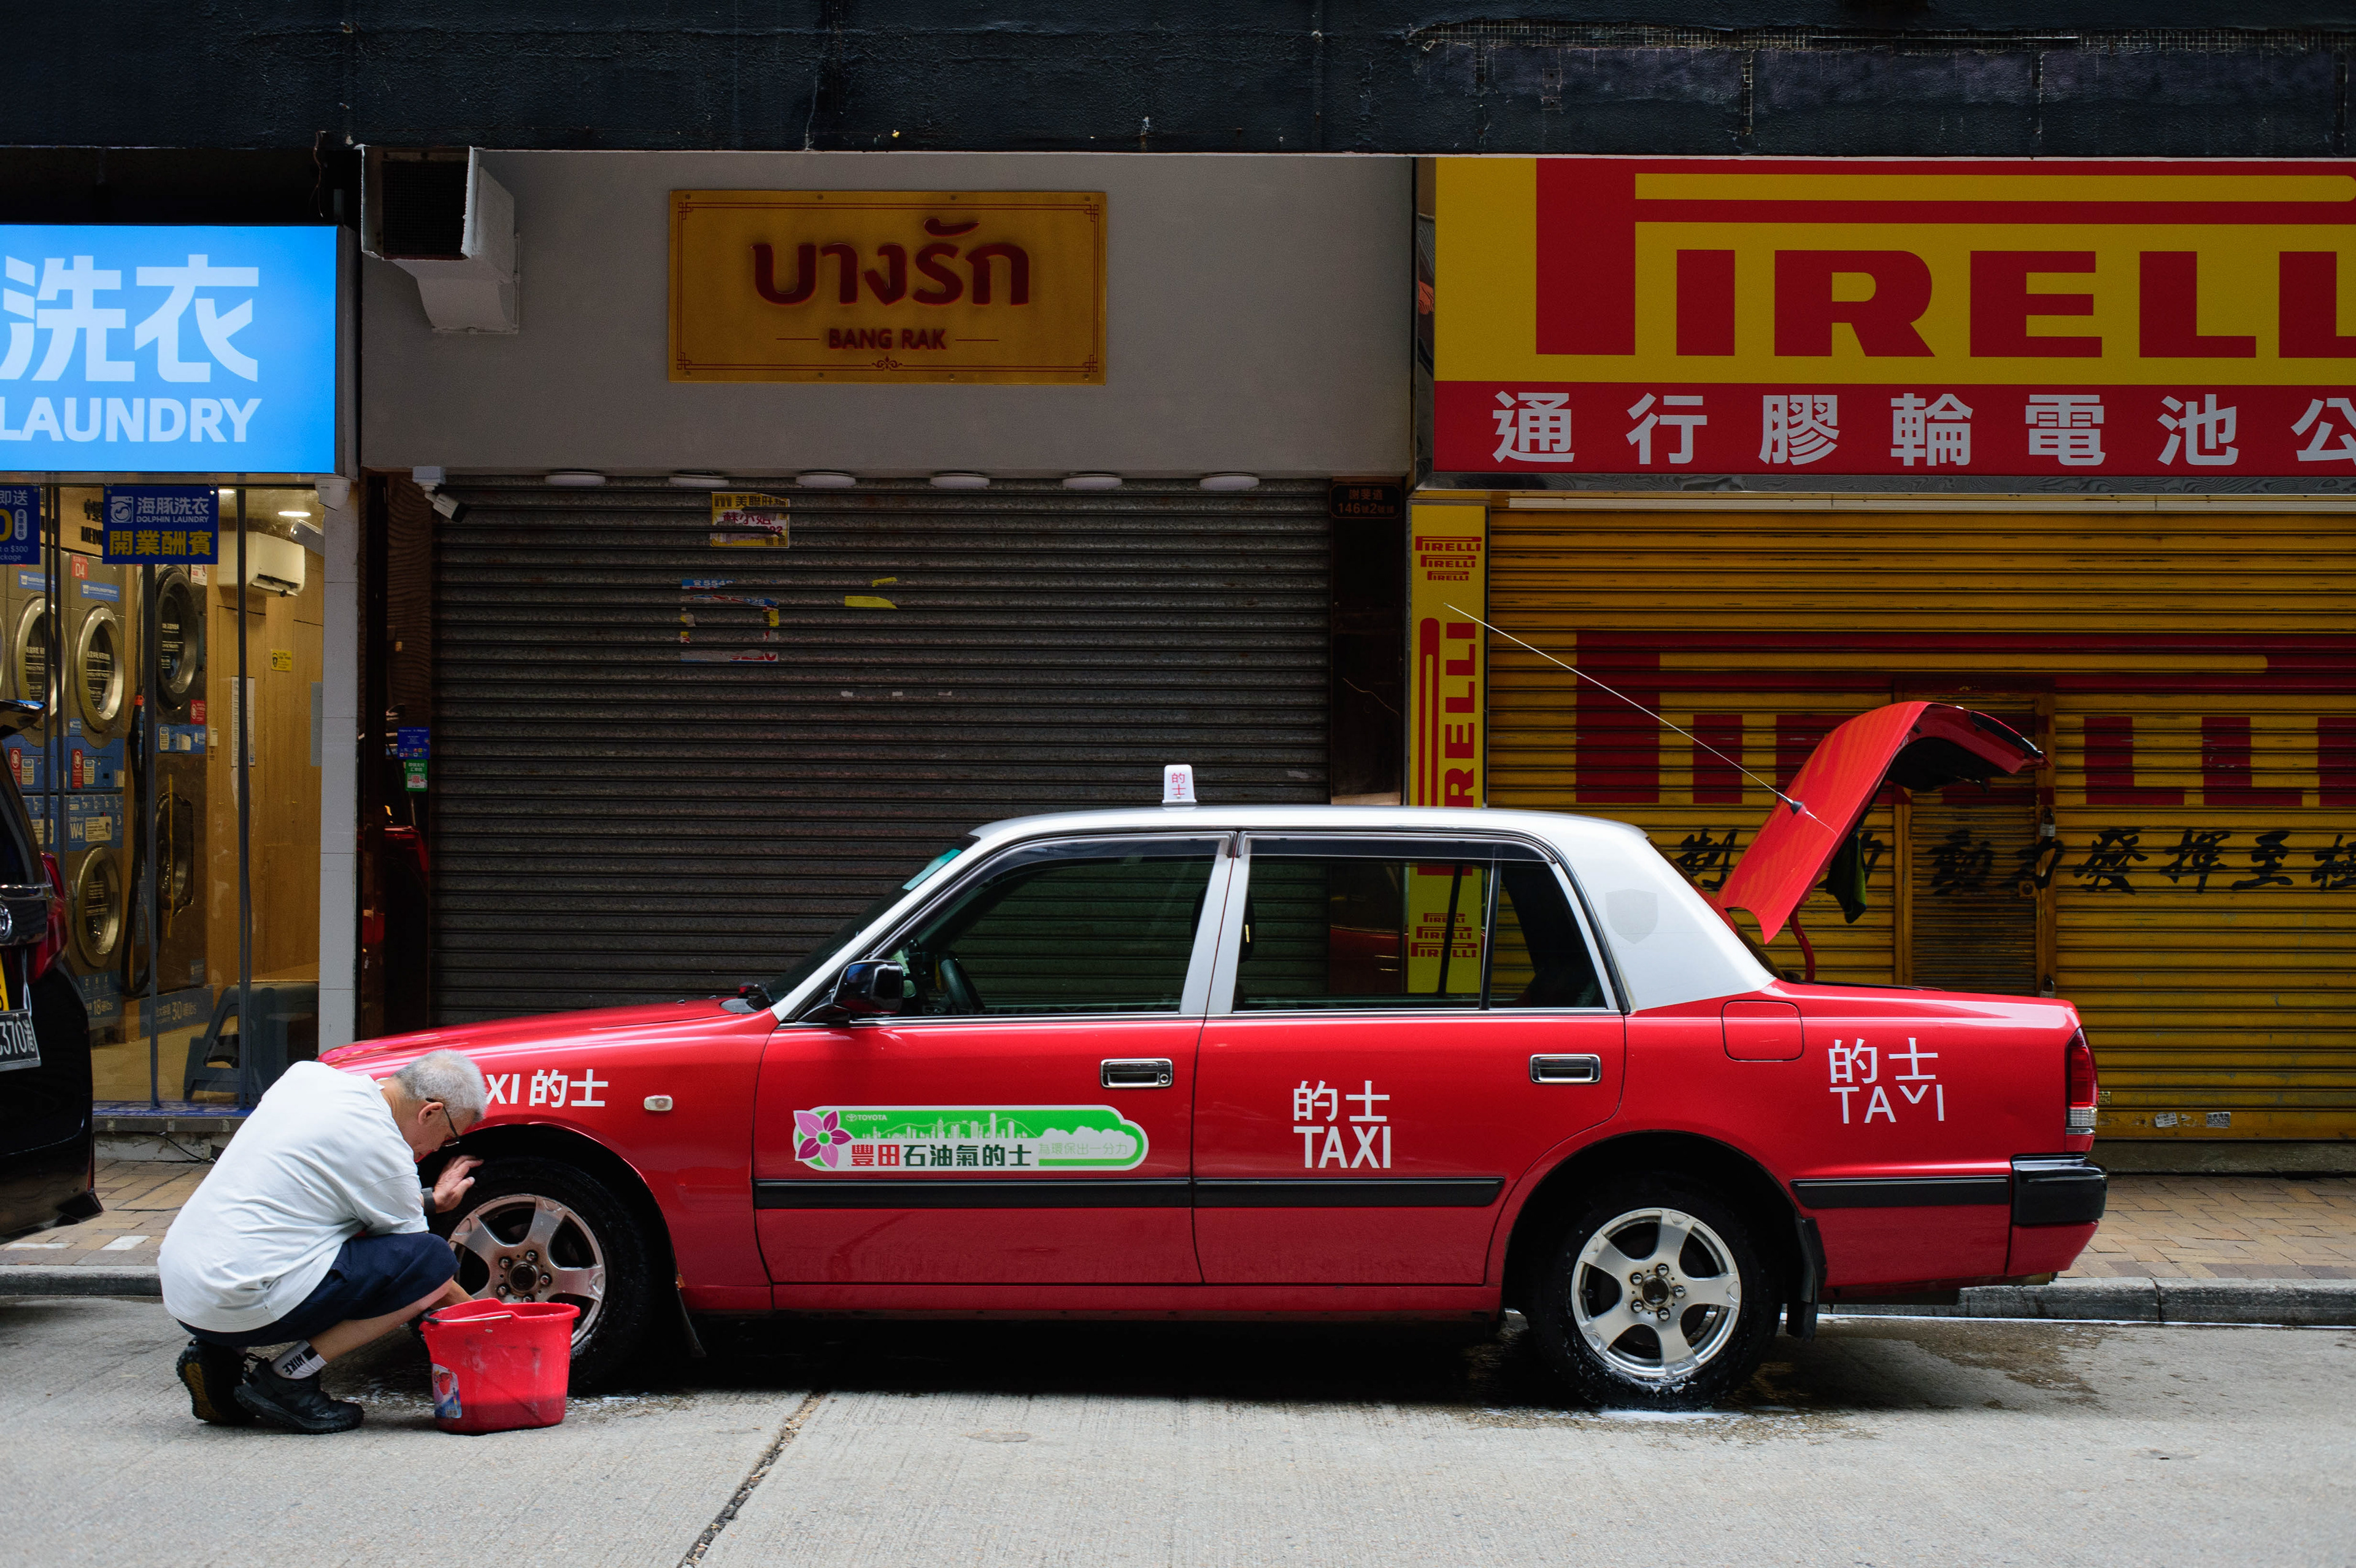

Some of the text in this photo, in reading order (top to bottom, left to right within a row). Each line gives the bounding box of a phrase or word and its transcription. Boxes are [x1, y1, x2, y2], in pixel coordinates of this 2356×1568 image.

[750, 218, 1030, 306] บางรัก
[1536, 158, 2356, 359] PIRELL
[0, 254, 260, 382] 洗衣
[828, 328, 947, 351] BANG RAK
[0, 396, 263, 443] LAUNDRY
[1492, 391, 2356, 466] 通行膠輪電池公
[136, 496, 210, 515] 海豚洗衣
[10, 545, 29, 553] $300
[109, 529, 213, 556] 開業酬賓
[1415, 536, 1482, 551] PIRELLI
[1420, 555, 1477, 567] PIRELLI
[1427, 571, 1469, 581] PIRELLI
[1576, 632, 2356, 807] PILLI
[1171, 772, 1186, 796] 的士
[1423, 913, 1466, 923] PIRELI
[1416, 926, 1472, 939] PIRLLI
[1411, 942, 1478, 958] PIRLLI
[1828, 1037, 1939, 1084] 的士
[485, 1069, 609, 1108] XI 的士
[1293, 1080, 1391, 1123] 的士
[851, 1143, 1032, 1167] 豐田石油氣的士
[1293, 1125, 1392, 1169] TAXI
[282, 1353, 306, 1375] NIKE
